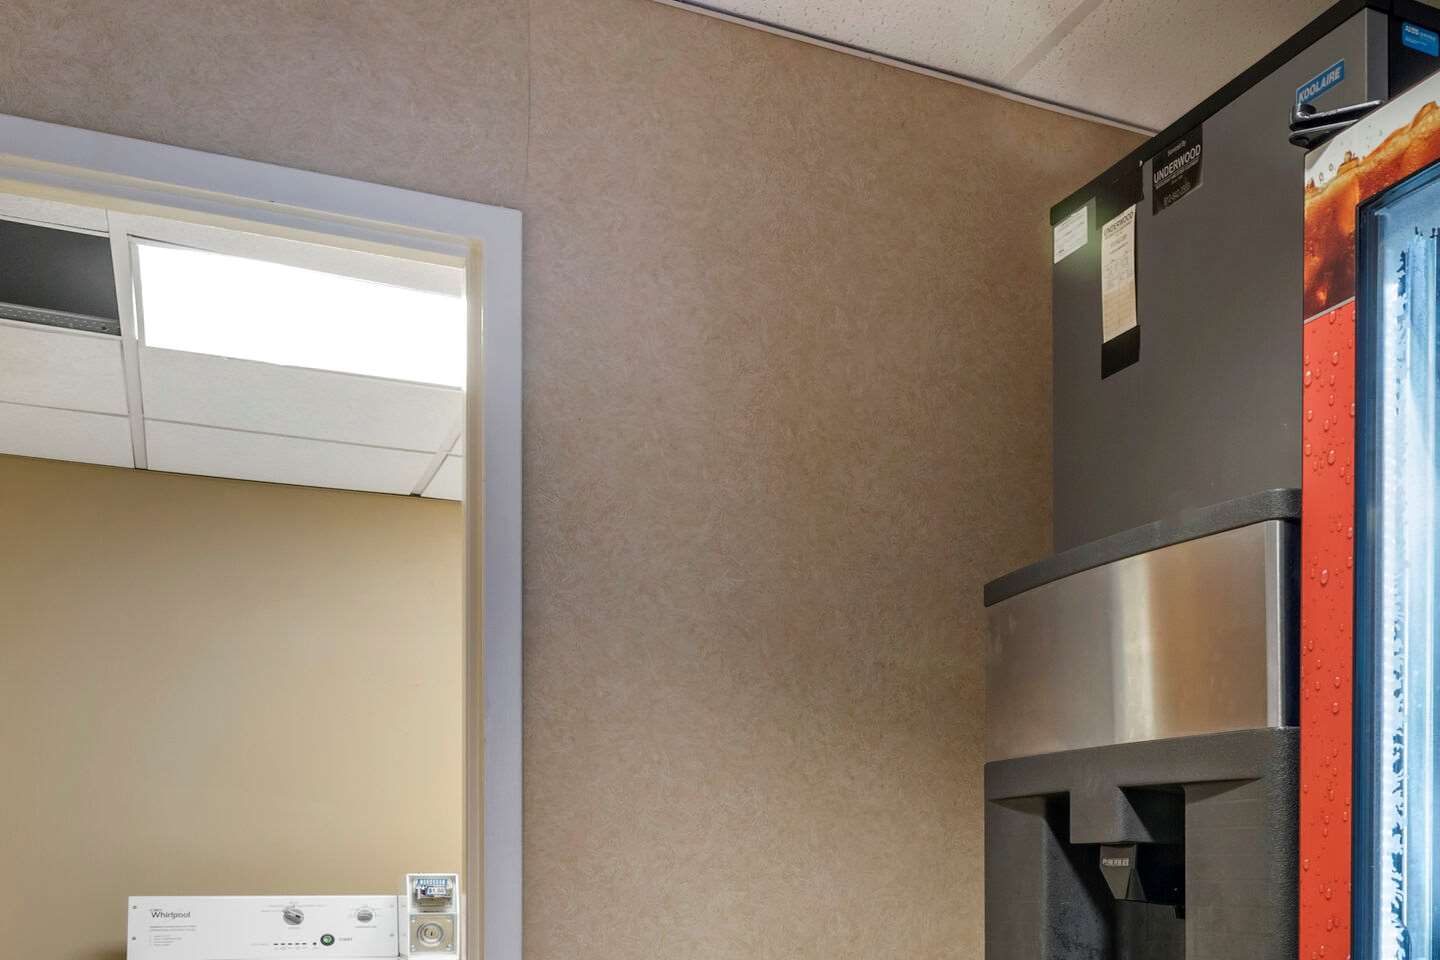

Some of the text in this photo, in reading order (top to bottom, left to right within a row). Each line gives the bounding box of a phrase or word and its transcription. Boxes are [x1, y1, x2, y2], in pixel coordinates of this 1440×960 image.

[1299, 67, 1342, 102] KOOLAIRE
[1153, 144, 1201, 184] UNDERWOOD
[151, 911, 191, 920] Whirlpool
